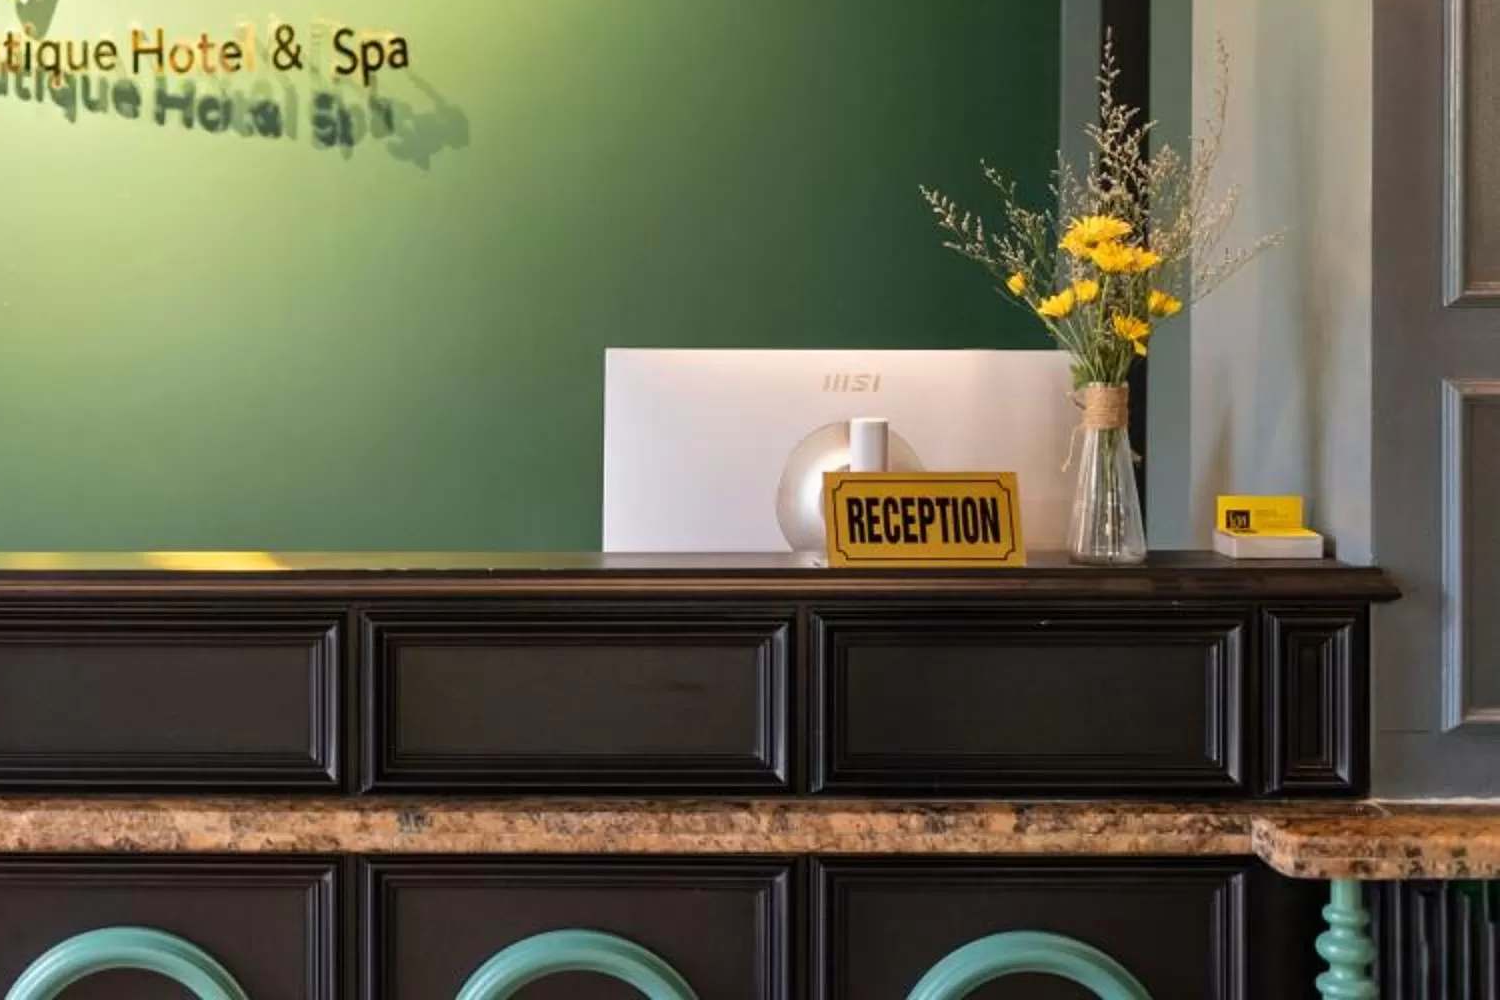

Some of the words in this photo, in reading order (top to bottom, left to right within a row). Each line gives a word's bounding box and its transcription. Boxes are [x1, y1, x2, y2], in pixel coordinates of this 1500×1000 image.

[131, 24, 255, 73] Hotel
[272, 23, 303, 71] &
[333, 27, 409, 86] Spa
[845, 496, 1000, 544] RECEPTION
